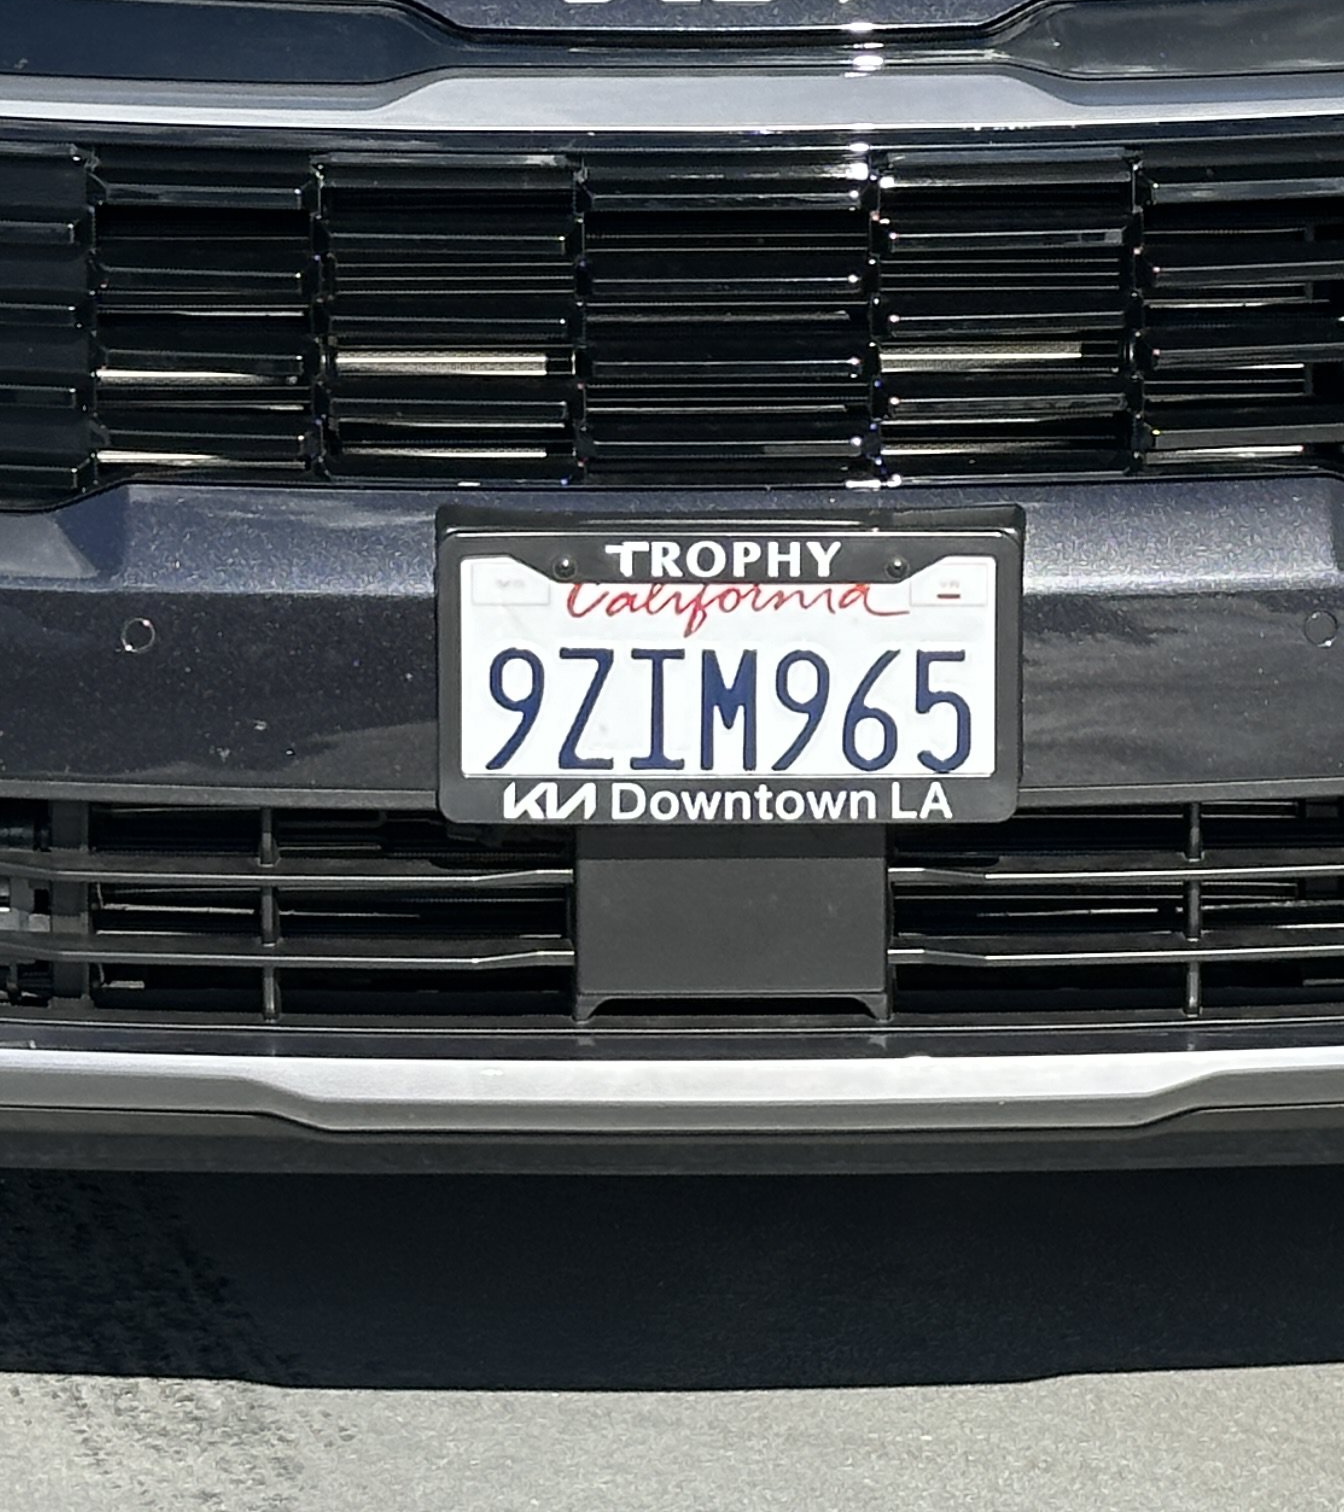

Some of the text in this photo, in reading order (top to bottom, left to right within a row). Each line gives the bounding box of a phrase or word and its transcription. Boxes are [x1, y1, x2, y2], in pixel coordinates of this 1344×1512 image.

[605, 541, 842, 578] TROPHY
[566, 582, 911, 638] California
[486, 647, 972, 773] 9ZIM965
[503, 781, 954, 821] KIA Downtown LA
